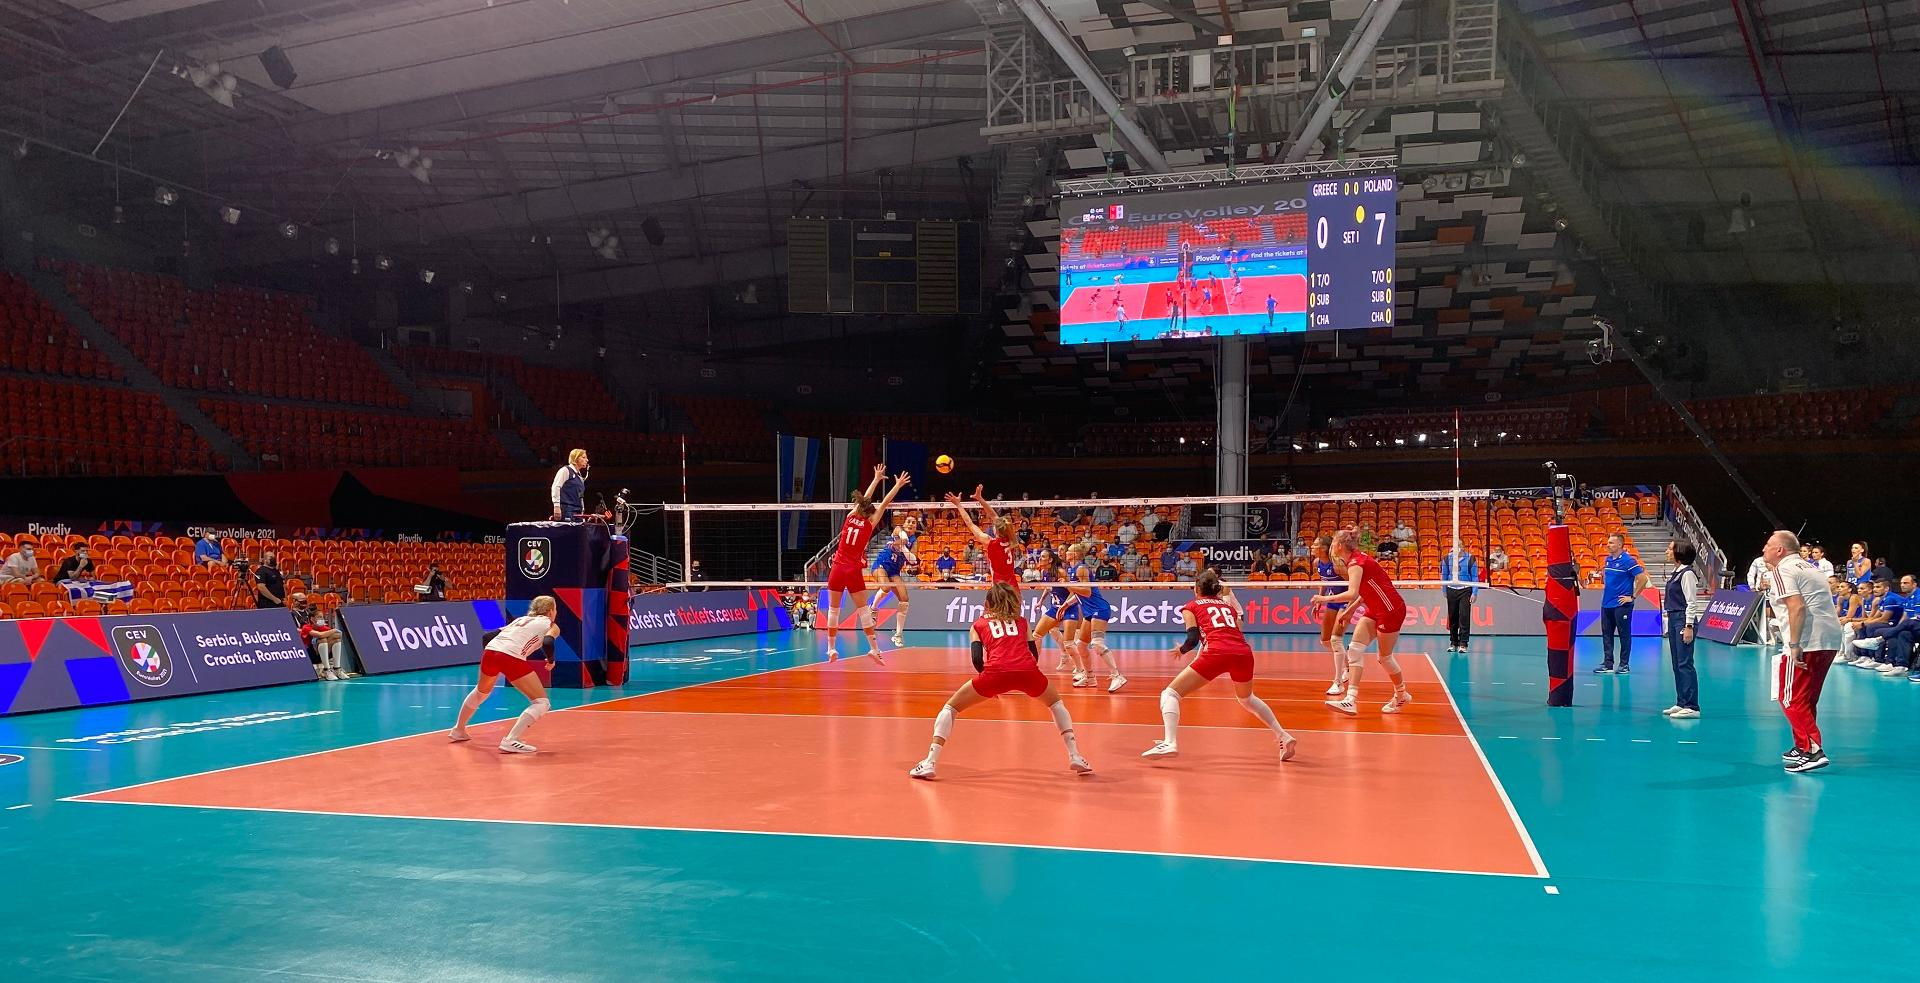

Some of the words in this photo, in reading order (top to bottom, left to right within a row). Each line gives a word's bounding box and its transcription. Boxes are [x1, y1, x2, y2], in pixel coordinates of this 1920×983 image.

[1313, 182, 1338, 196] GREECE
[1344, 182, 1350, 196] 0
[1353, 182, 1359, 195] 0
[1364, 179, 1393, 193] POLAND
[1128, 204, 1265, 223] EuroVolley
[1316, 216, 1329, 249] 0
[1343, 231, 1355, 244] SET
[1374, 212, 1386, 245] 7
[1310, 272, 1315, 288] 1
[1317, 273, 1330, 286] T/O
[1372, 270, 1385, 285] T/O
[1385, 268, 1392, 284] 0
[1309, 293, 1315, 308] 0
[1316, 293, 1330, 306] SUB
[1371, 290, 1385, 303] SUB
[1385, 288, 1392, 304] 0
[1310, 312, 1315, 328] 1
[1316, 313, 1330, 325] CHA
[1371, 311, 1385, 323] CHA
[1385, 308, 1392, 324] 0
[1591, 488, 1625, 499] lovdiv
[28, 522, 71, 536] Plovdiv
[187, 526, 206, 538] CEV
[215, 527, 256, 539] uroVolley
[257, 528, 276, 539] 2021
[845, 526, 860, 546] 11
[398, 533, 423, 543] Plovdiv
[484, 535, 496, 544] CEV
[628, 609, 663, 630] ckets
[664, 609, 678, 627] at
[677, 605, 749, 626] tickets.cev.eu
[946, 597, 985, 623] fin
[1021, 597, 1049, 623] th
[1107, 597, 1186, 624] ckets
[1206, 606, 1236, 628] 26
[125, 630, 147, 639] CEV
[372, 615, 468, 652] Plovdiv
[988, 619, 1019, 639] 88
[196, 634, 242, 649] Serbia,
[243, 629, 292, 647] Bulgaria
[203, 651, 256, 668] Croatia,
[256, 647, 307, 662] Romania
